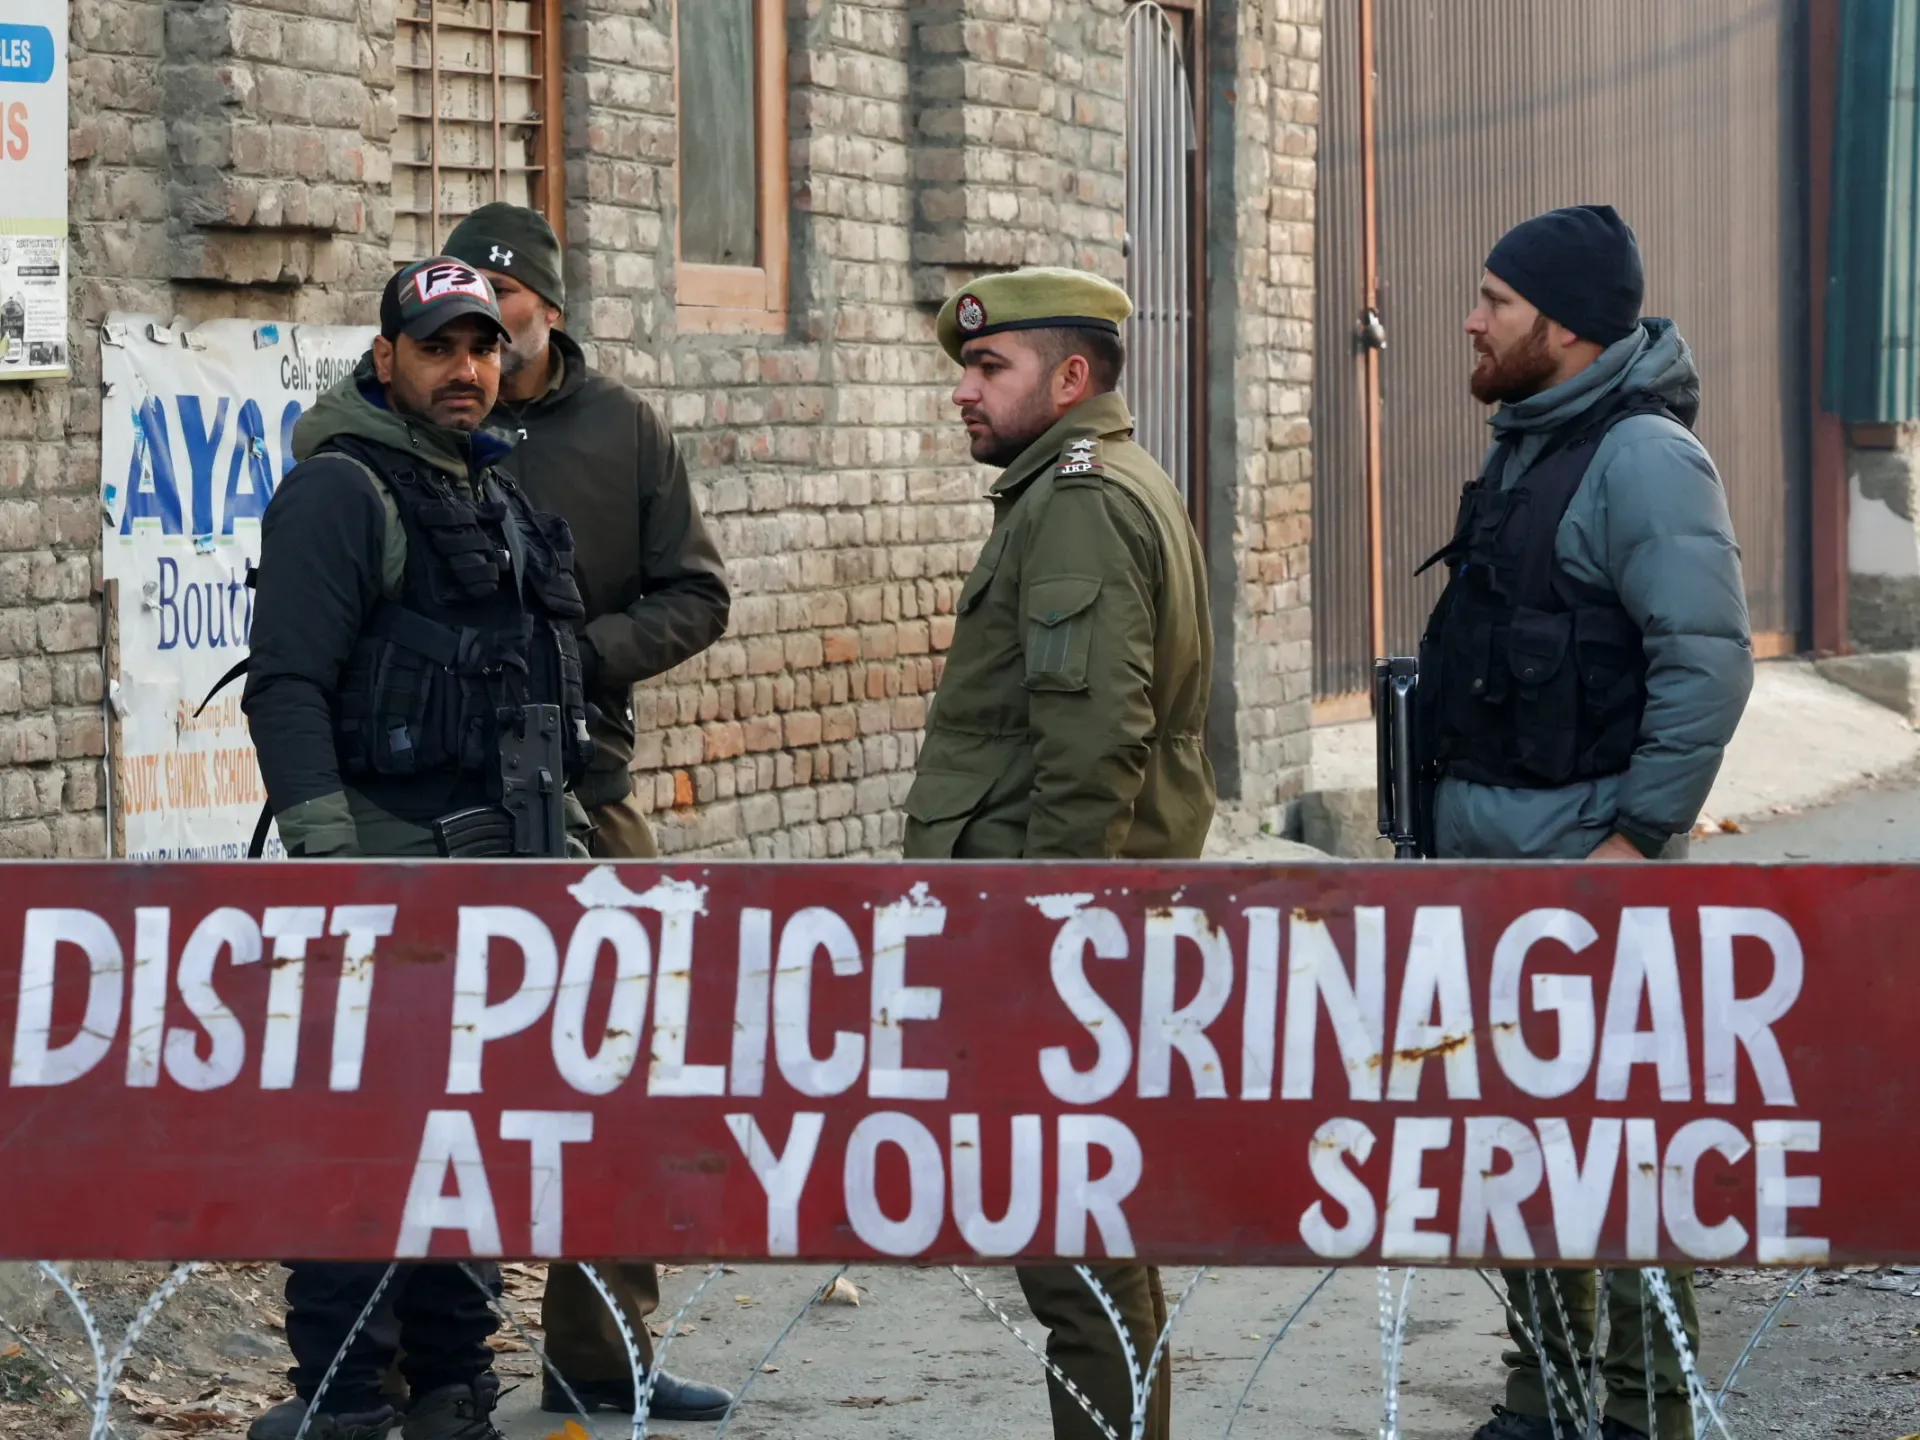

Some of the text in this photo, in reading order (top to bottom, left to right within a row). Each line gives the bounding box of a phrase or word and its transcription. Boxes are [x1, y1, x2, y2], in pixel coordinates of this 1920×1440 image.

[0, 38, 31, 68] LES
[280, 354, 311, 391] Cell:
[1062, 463, 1092, 474] JKP
[223, 695, 236, 729] All
[214, 747, 259, 806] SCHOOL
[10, 900, 1804, 1106] DISTT POLICE SRINAGAR
[395, 1110, 1830, 1263] AT YOUR SERVICE
